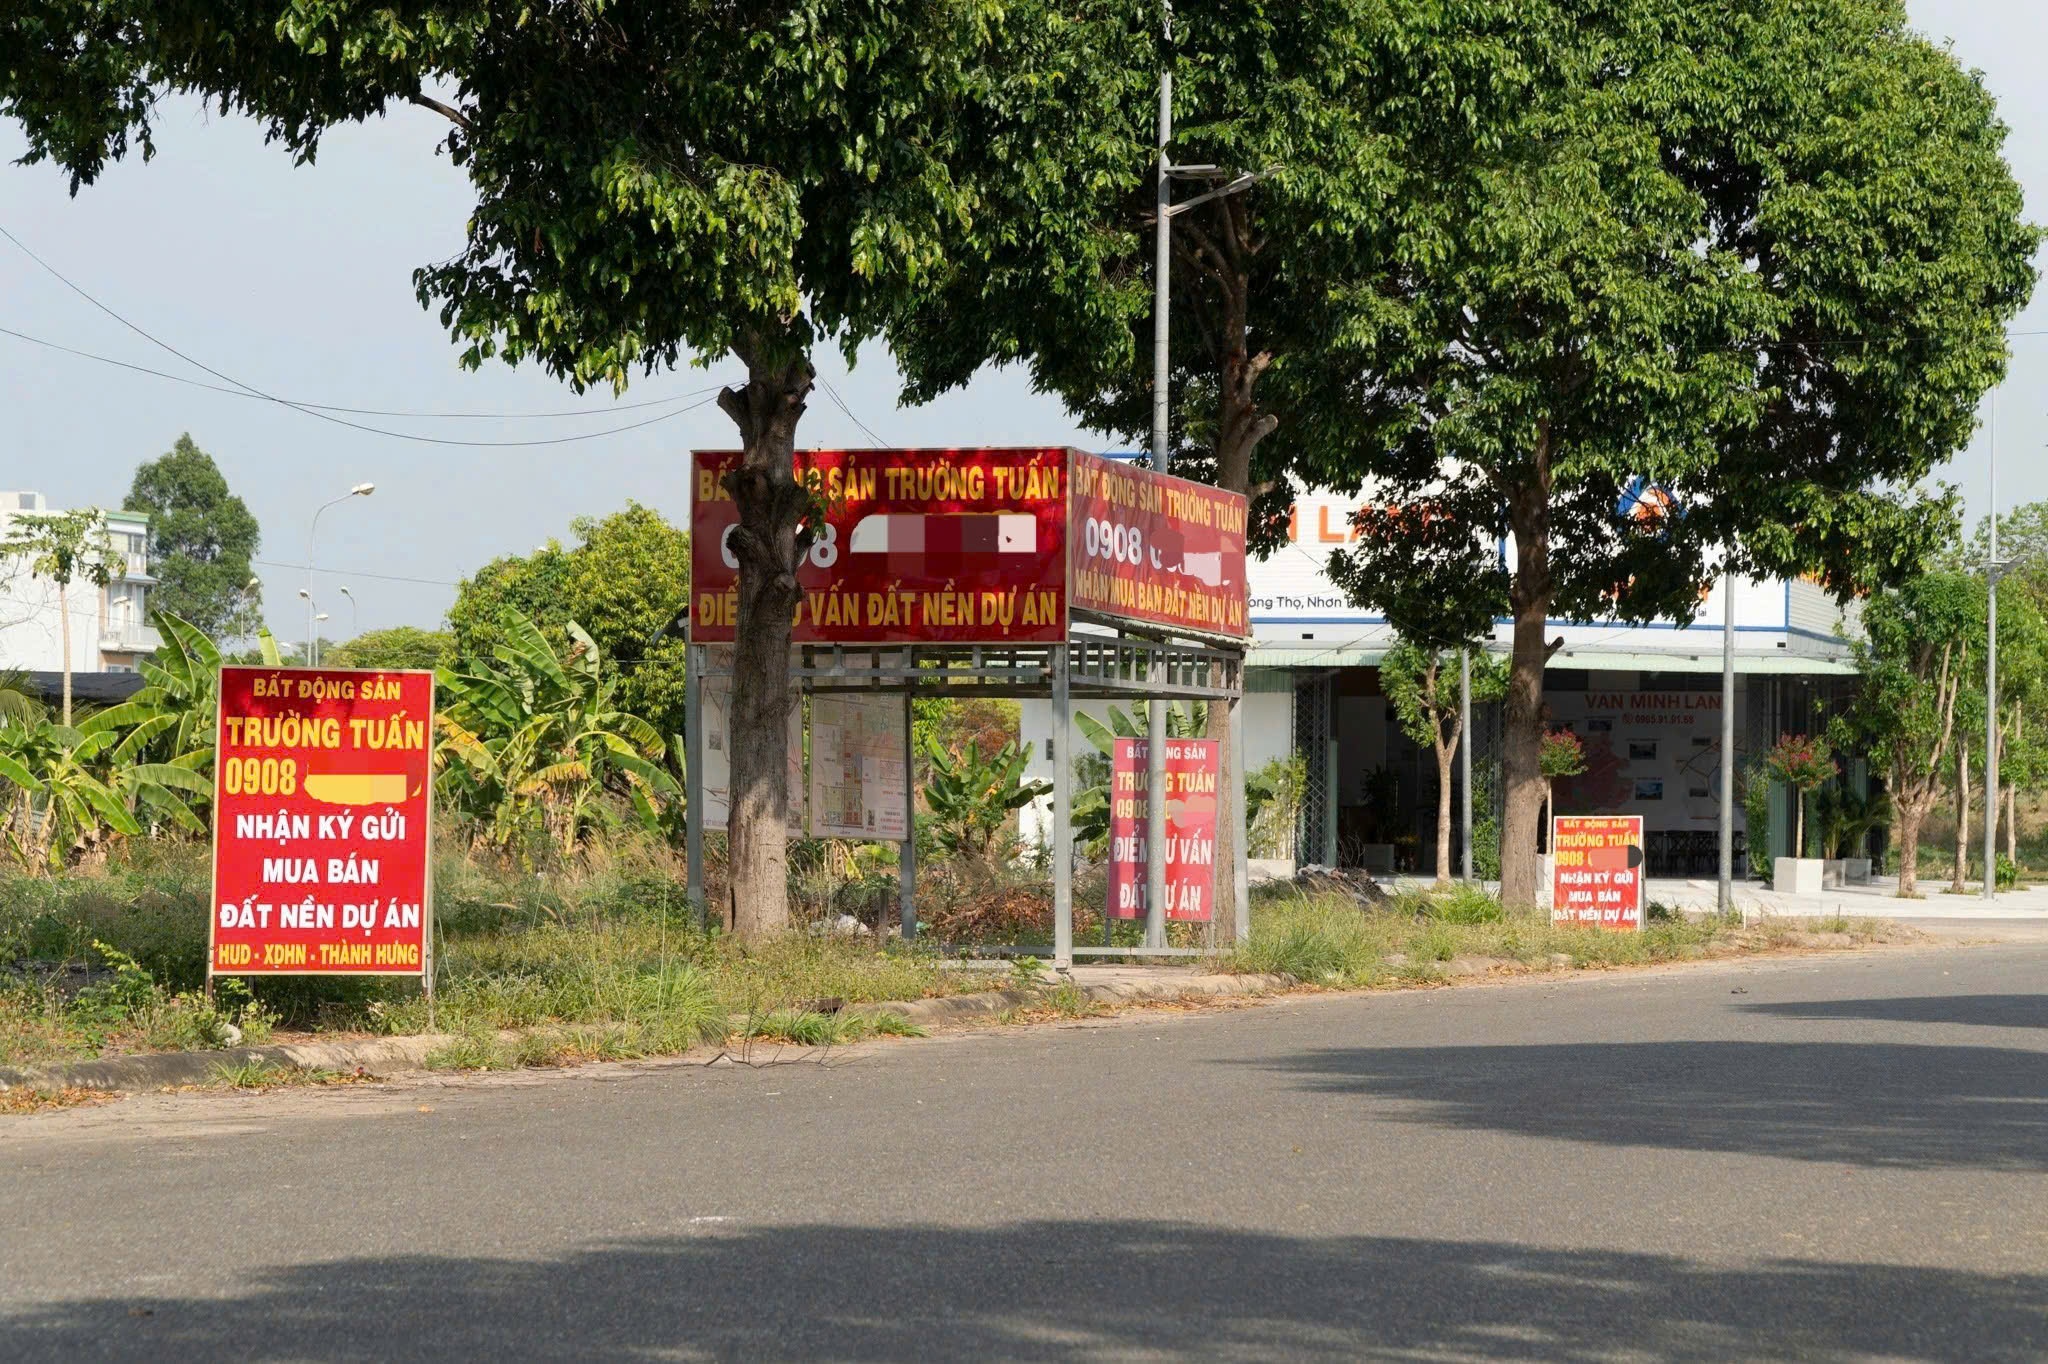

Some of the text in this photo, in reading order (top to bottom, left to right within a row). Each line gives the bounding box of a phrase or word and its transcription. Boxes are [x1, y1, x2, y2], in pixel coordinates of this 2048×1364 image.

[699, 456, 733, 501] BẤ
[828, 455, 876, 501] SẢN
[885, 457, 984, 500] TRƯỜNG
[992, 452, 1059, 500] TUẤN
[1075, 457, 1099, 498] BẤT
[1102, 467, 1135, 511] ĐỘNG
[1139, 473, 1163, 513] SẢN
[1166, 487, 1211, 527] TRƯỜNG
[1214, 495, 1242, 535] TUẤN
[1085, 517, 1143, 565] 0908
[699, 574, 740, 627] ĐIỂ
[809, 579, 859, 627] VẤN
[867, 579, 914, 627] ĐẤT
[923, 578, 974, 626] NỀN
[981, 584, 1017, 635] DỰ
[1022, 582, 1056, 626] ÁN
[1111, 576, 1135, 608] MUA
[1138, 577, 1162, 612] BÁN
[1164, 580, 1187, 618] ĐẤT
[1189, 583, 1209, 622] NỀN
[1212, 593, 1226, 632] DỰ
[1228, 593, 1242, 627] ÁN
[1248, 598, 1273, 609] ong
[1276, 596, 1304, 610] Thọ,
[1307, 596, 1342, 608] Nhơn
[253, 673, 401, 704] BẤT ĐỘNG SẢN
[1629, 694, 1680, 710] MINH
[226, 709, 423, 749] TRƯỜNG TUẤN
[1126, 742, 1149, 759] BẤT
[1184, 742, 1207, 760] SẢN
[225, 757, 297, 795] 0908
[1117, 764, 1215, 793] TRƯG TUẤN
[236, 807, 405, 845] NHẬN KÝ GỬI
[1556, 830, 1639, 848] TRƯỜNG TUẤN
[1165, 833, 1178, 865] Ư
[1180, 828, 1213, 865] VẤN
[1555, 850, 1584, 867] 0908
[262, 851, 379, 884] MUA BÁN
[1561, 870, 1592, 887] NHẬN
[1594, 870, 1610, 884] KÝ
[1164, 879, 1177, 918] Ự
[1179, 877, 1202, 911] ÁN
[1568, 888, 1621, 902] MUA BÁN
[220, 894, 420, 936] ĐẤT NỀN DỰ ÁN
[218, 943, 251, 964] HUD
[319, 939, 372, 965] THÀNH
[375, 940, 419, 965] HƯNG
